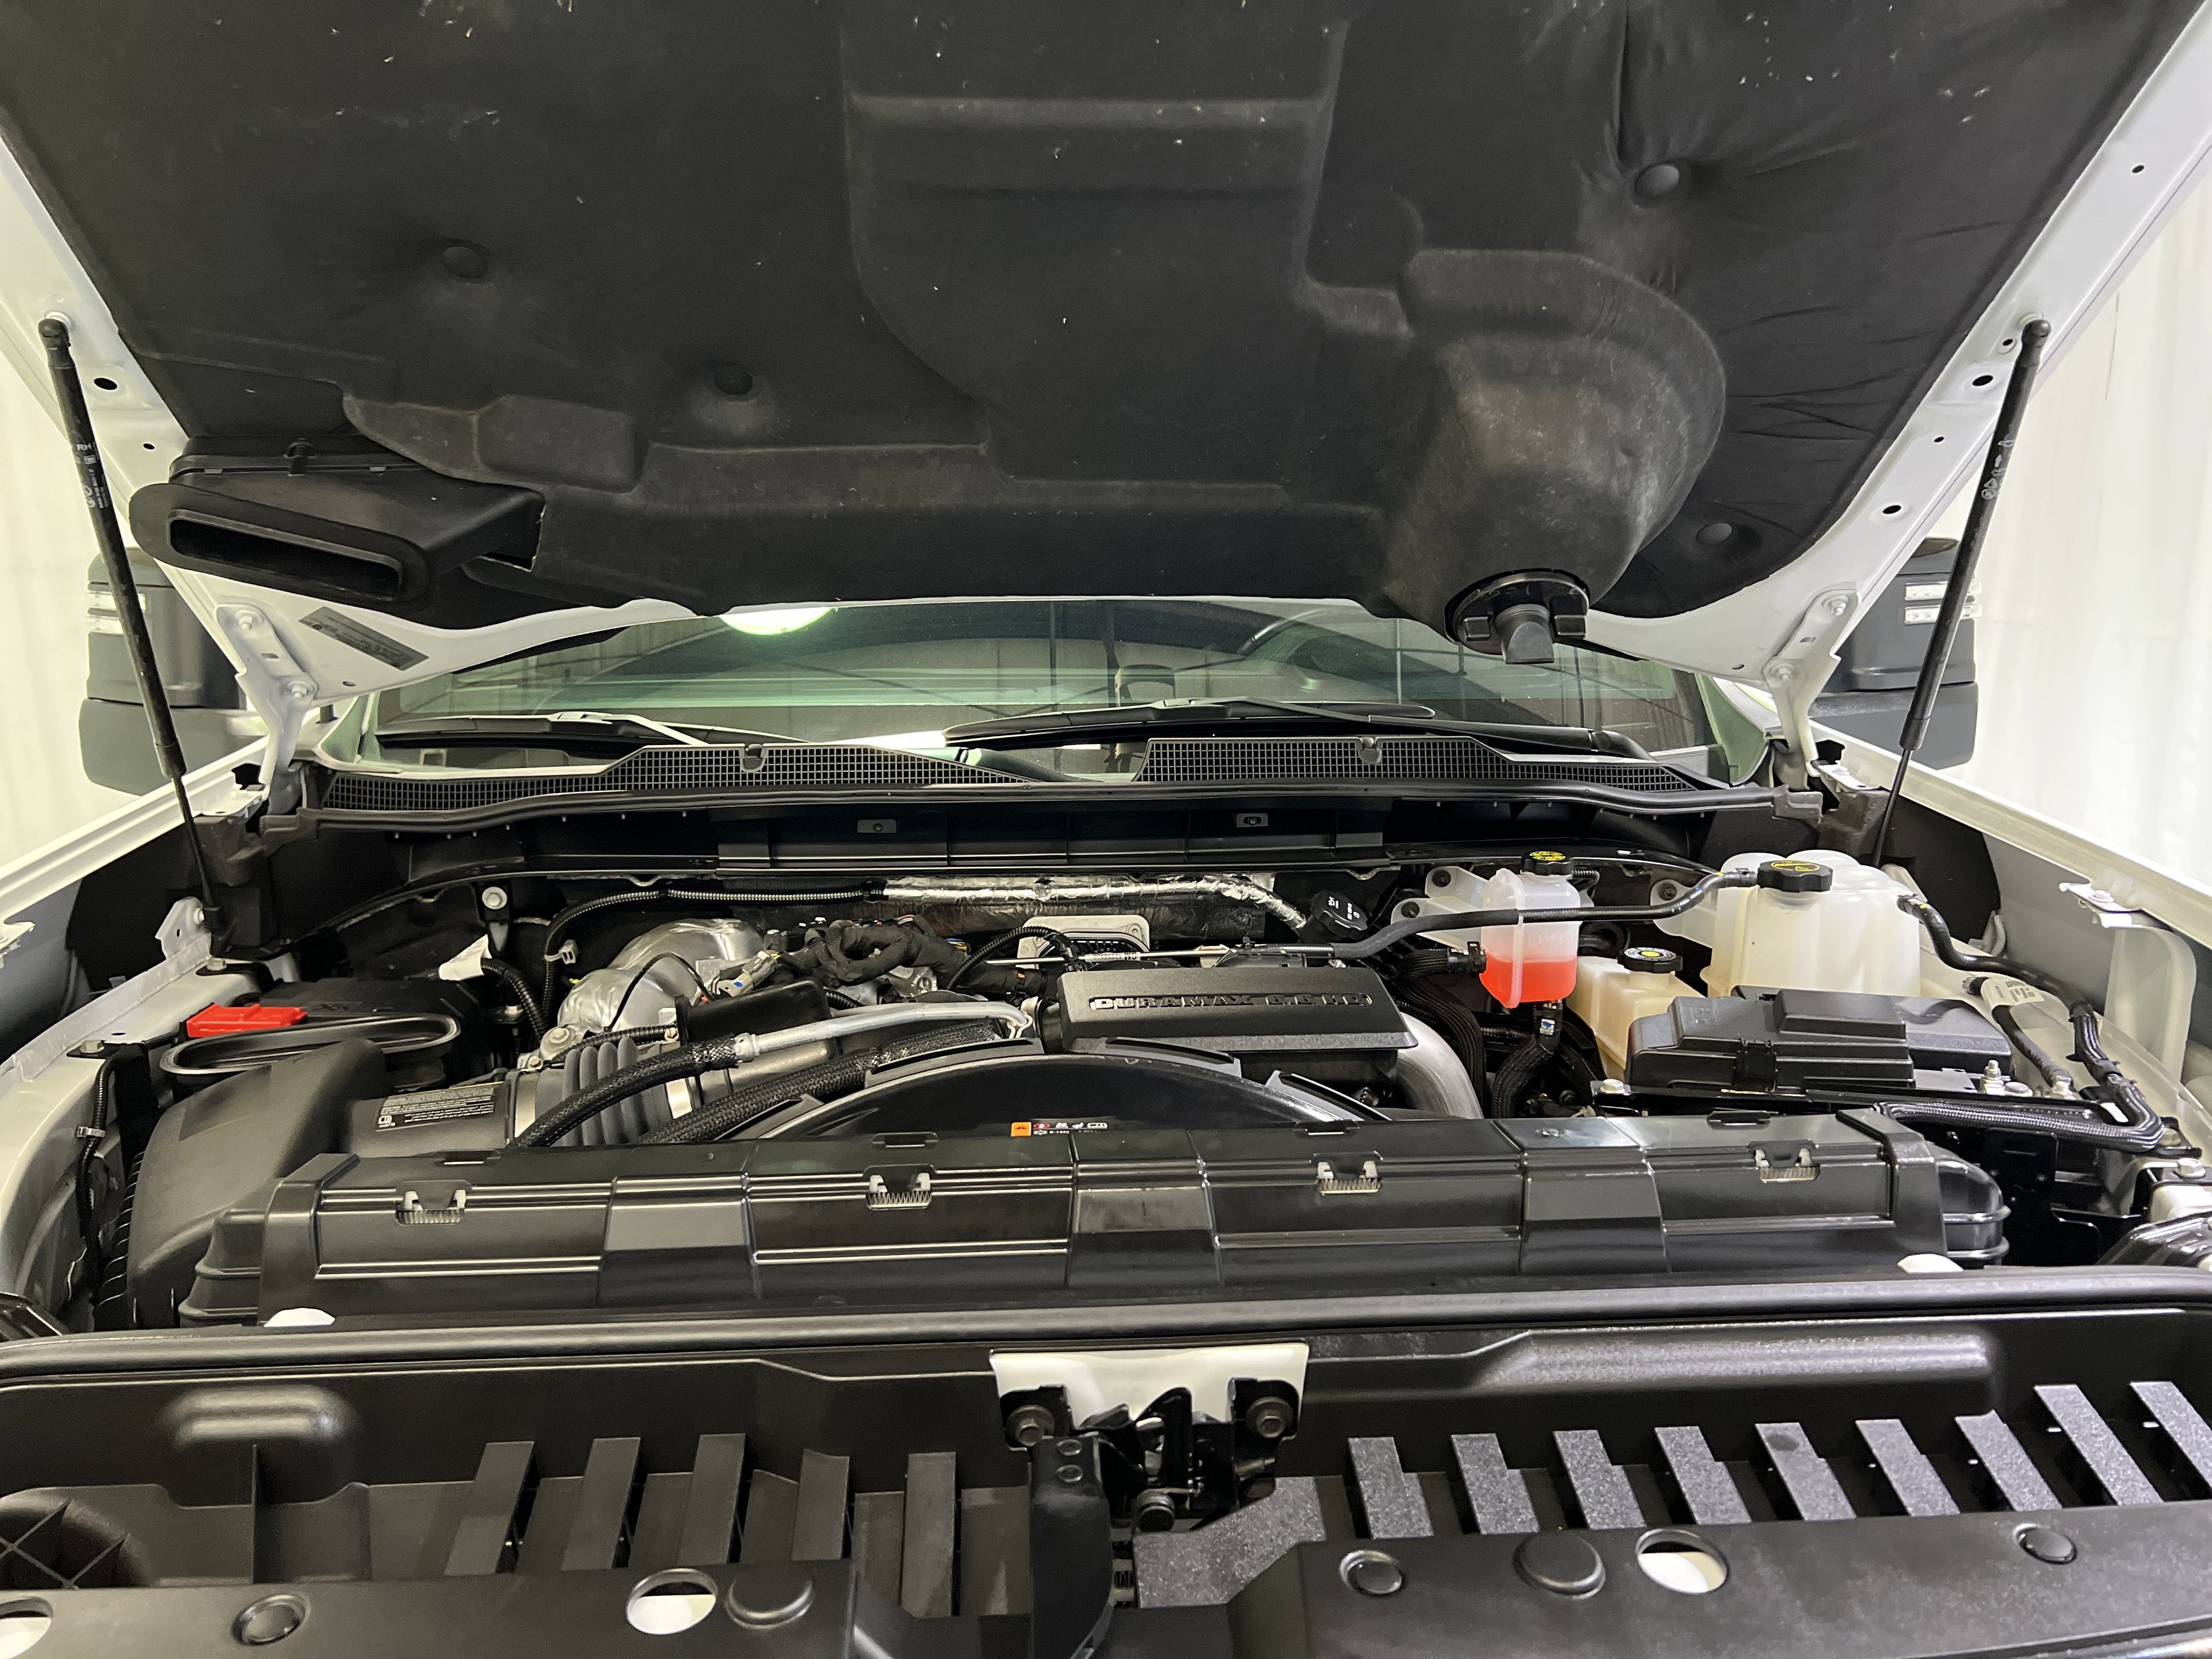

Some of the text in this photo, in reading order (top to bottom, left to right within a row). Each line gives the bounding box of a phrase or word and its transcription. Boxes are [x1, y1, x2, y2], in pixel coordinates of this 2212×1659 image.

[1091, 993, 1365, 1009] DURAMAX 6.6 HD
